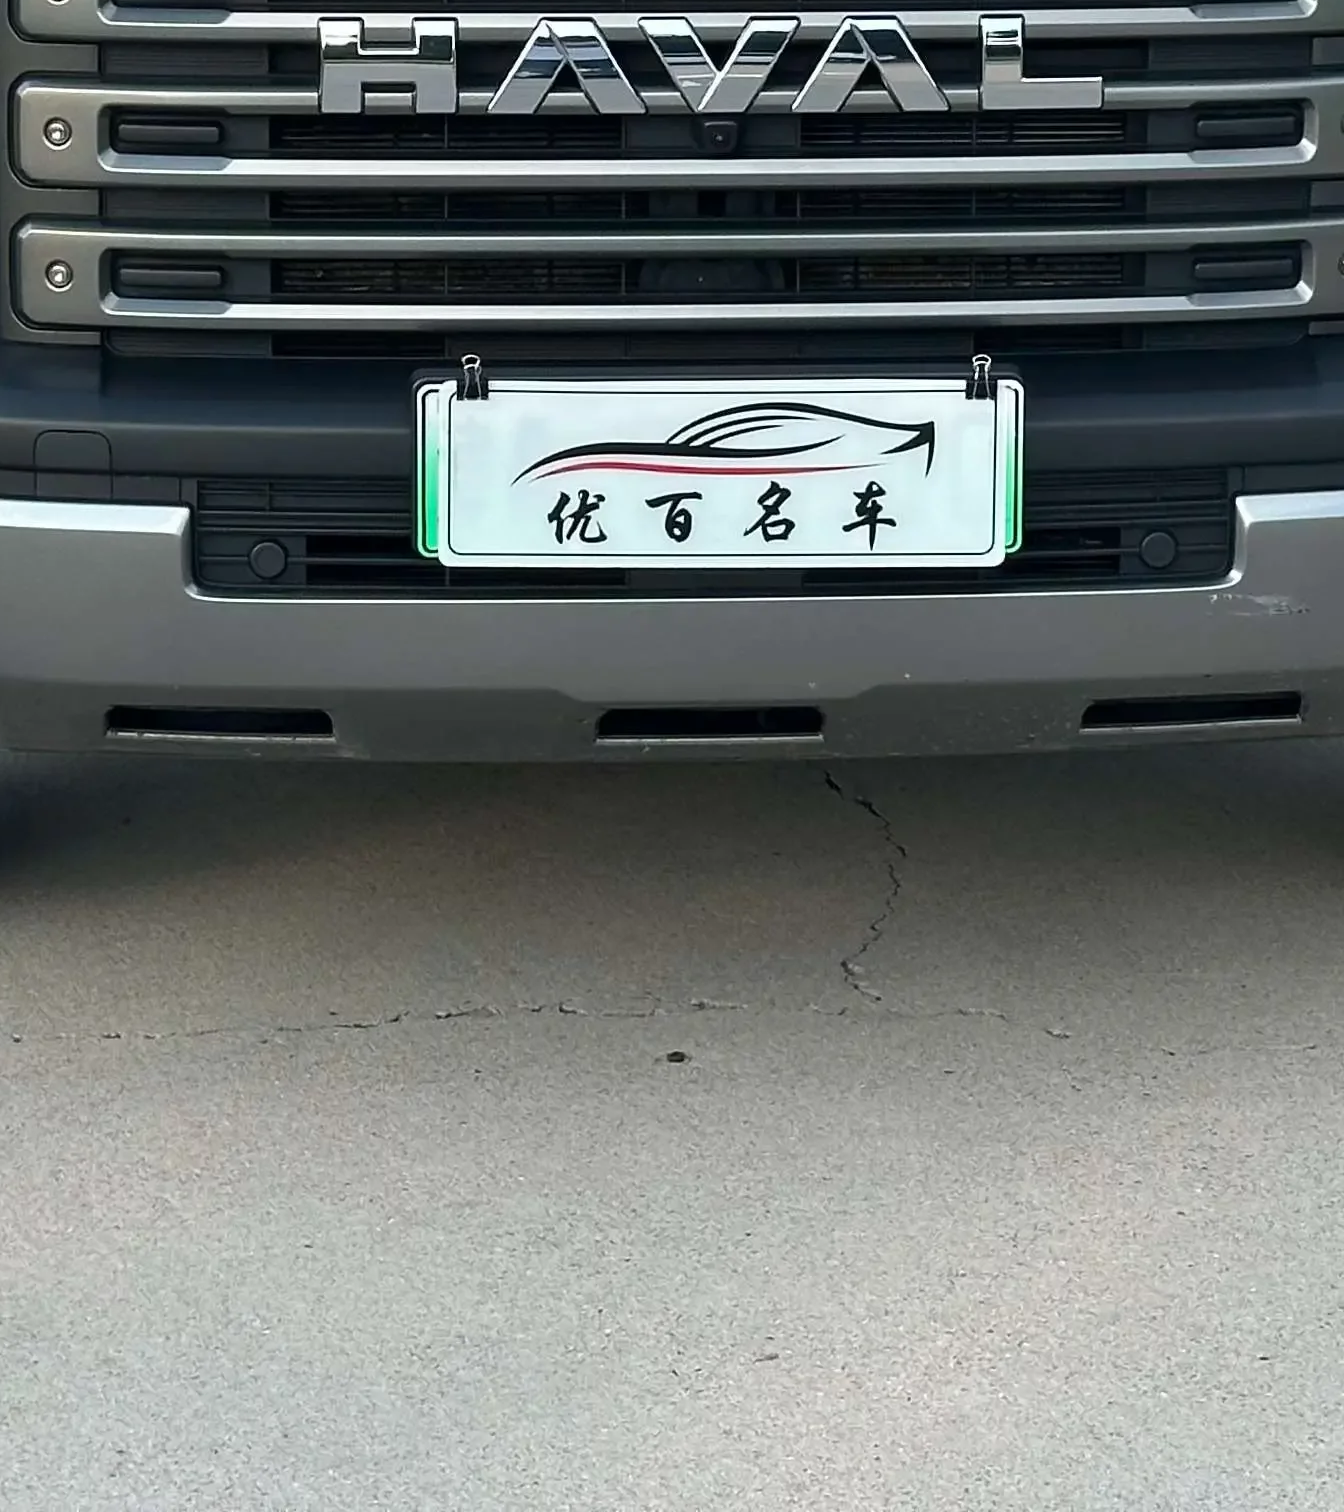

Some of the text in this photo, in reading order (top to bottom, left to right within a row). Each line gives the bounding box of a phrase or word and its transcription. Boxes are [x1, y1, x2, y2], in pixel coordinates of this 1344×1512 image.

[317, 15, 1104, 114] HAVAL
[547, 480, 898, 552] 优百名车
